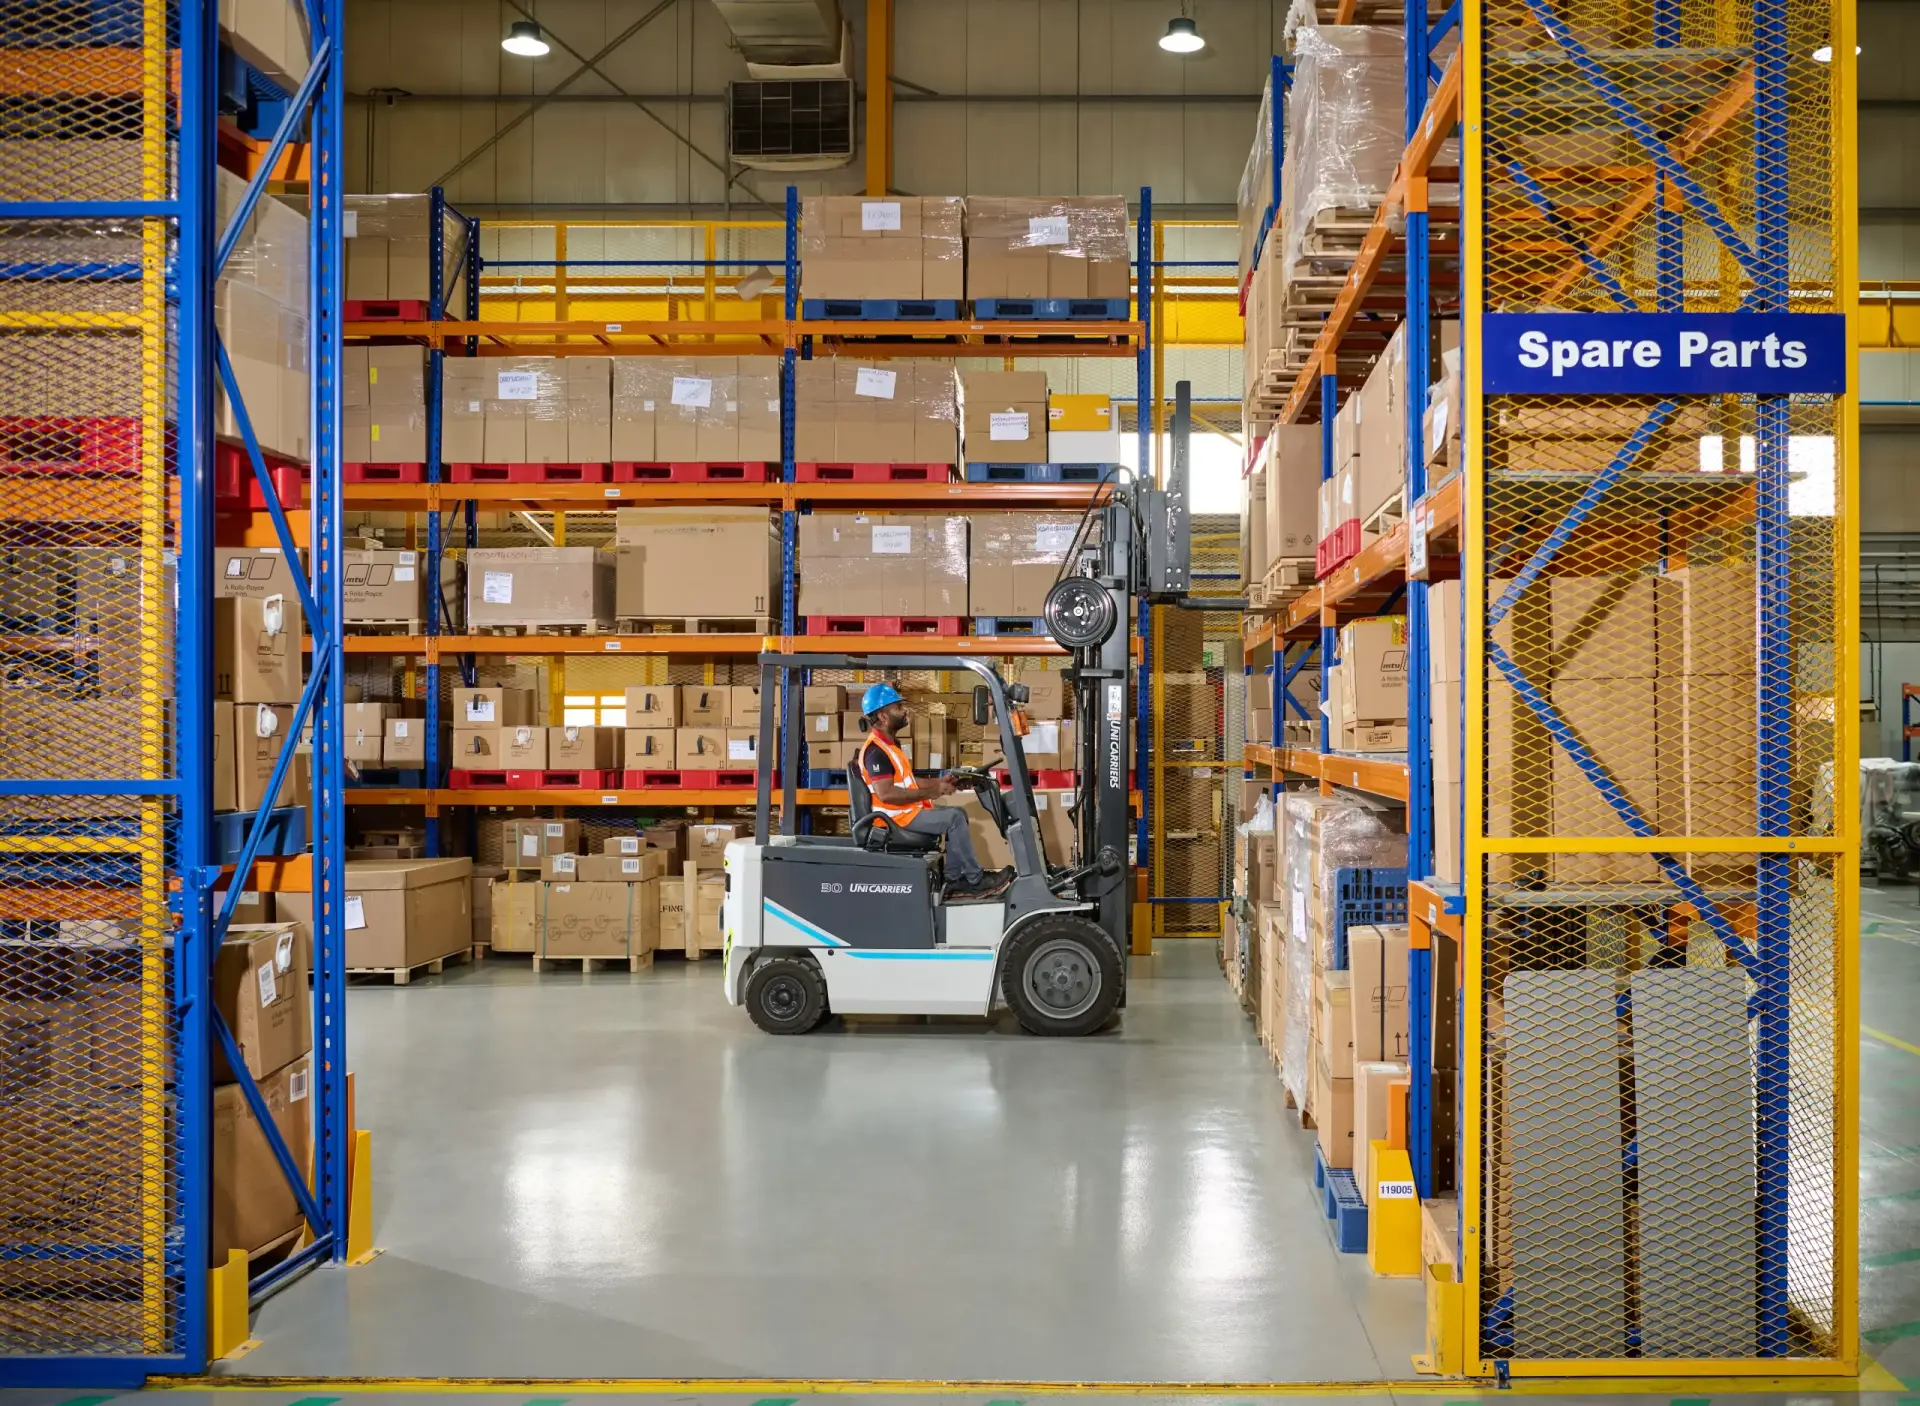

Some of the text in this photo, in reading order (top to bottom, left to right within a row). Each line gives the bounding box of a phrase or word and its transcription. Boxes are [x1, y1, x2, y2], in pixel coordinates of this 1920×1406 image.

[1518, 330, 1808, 377] Spare Parts
[1110, 720, 1120, 789] UNICARRIERS
[849, 882, 913, 894] UNICARRIERS
[1380, 1185, 1413, 1195] 119D05
